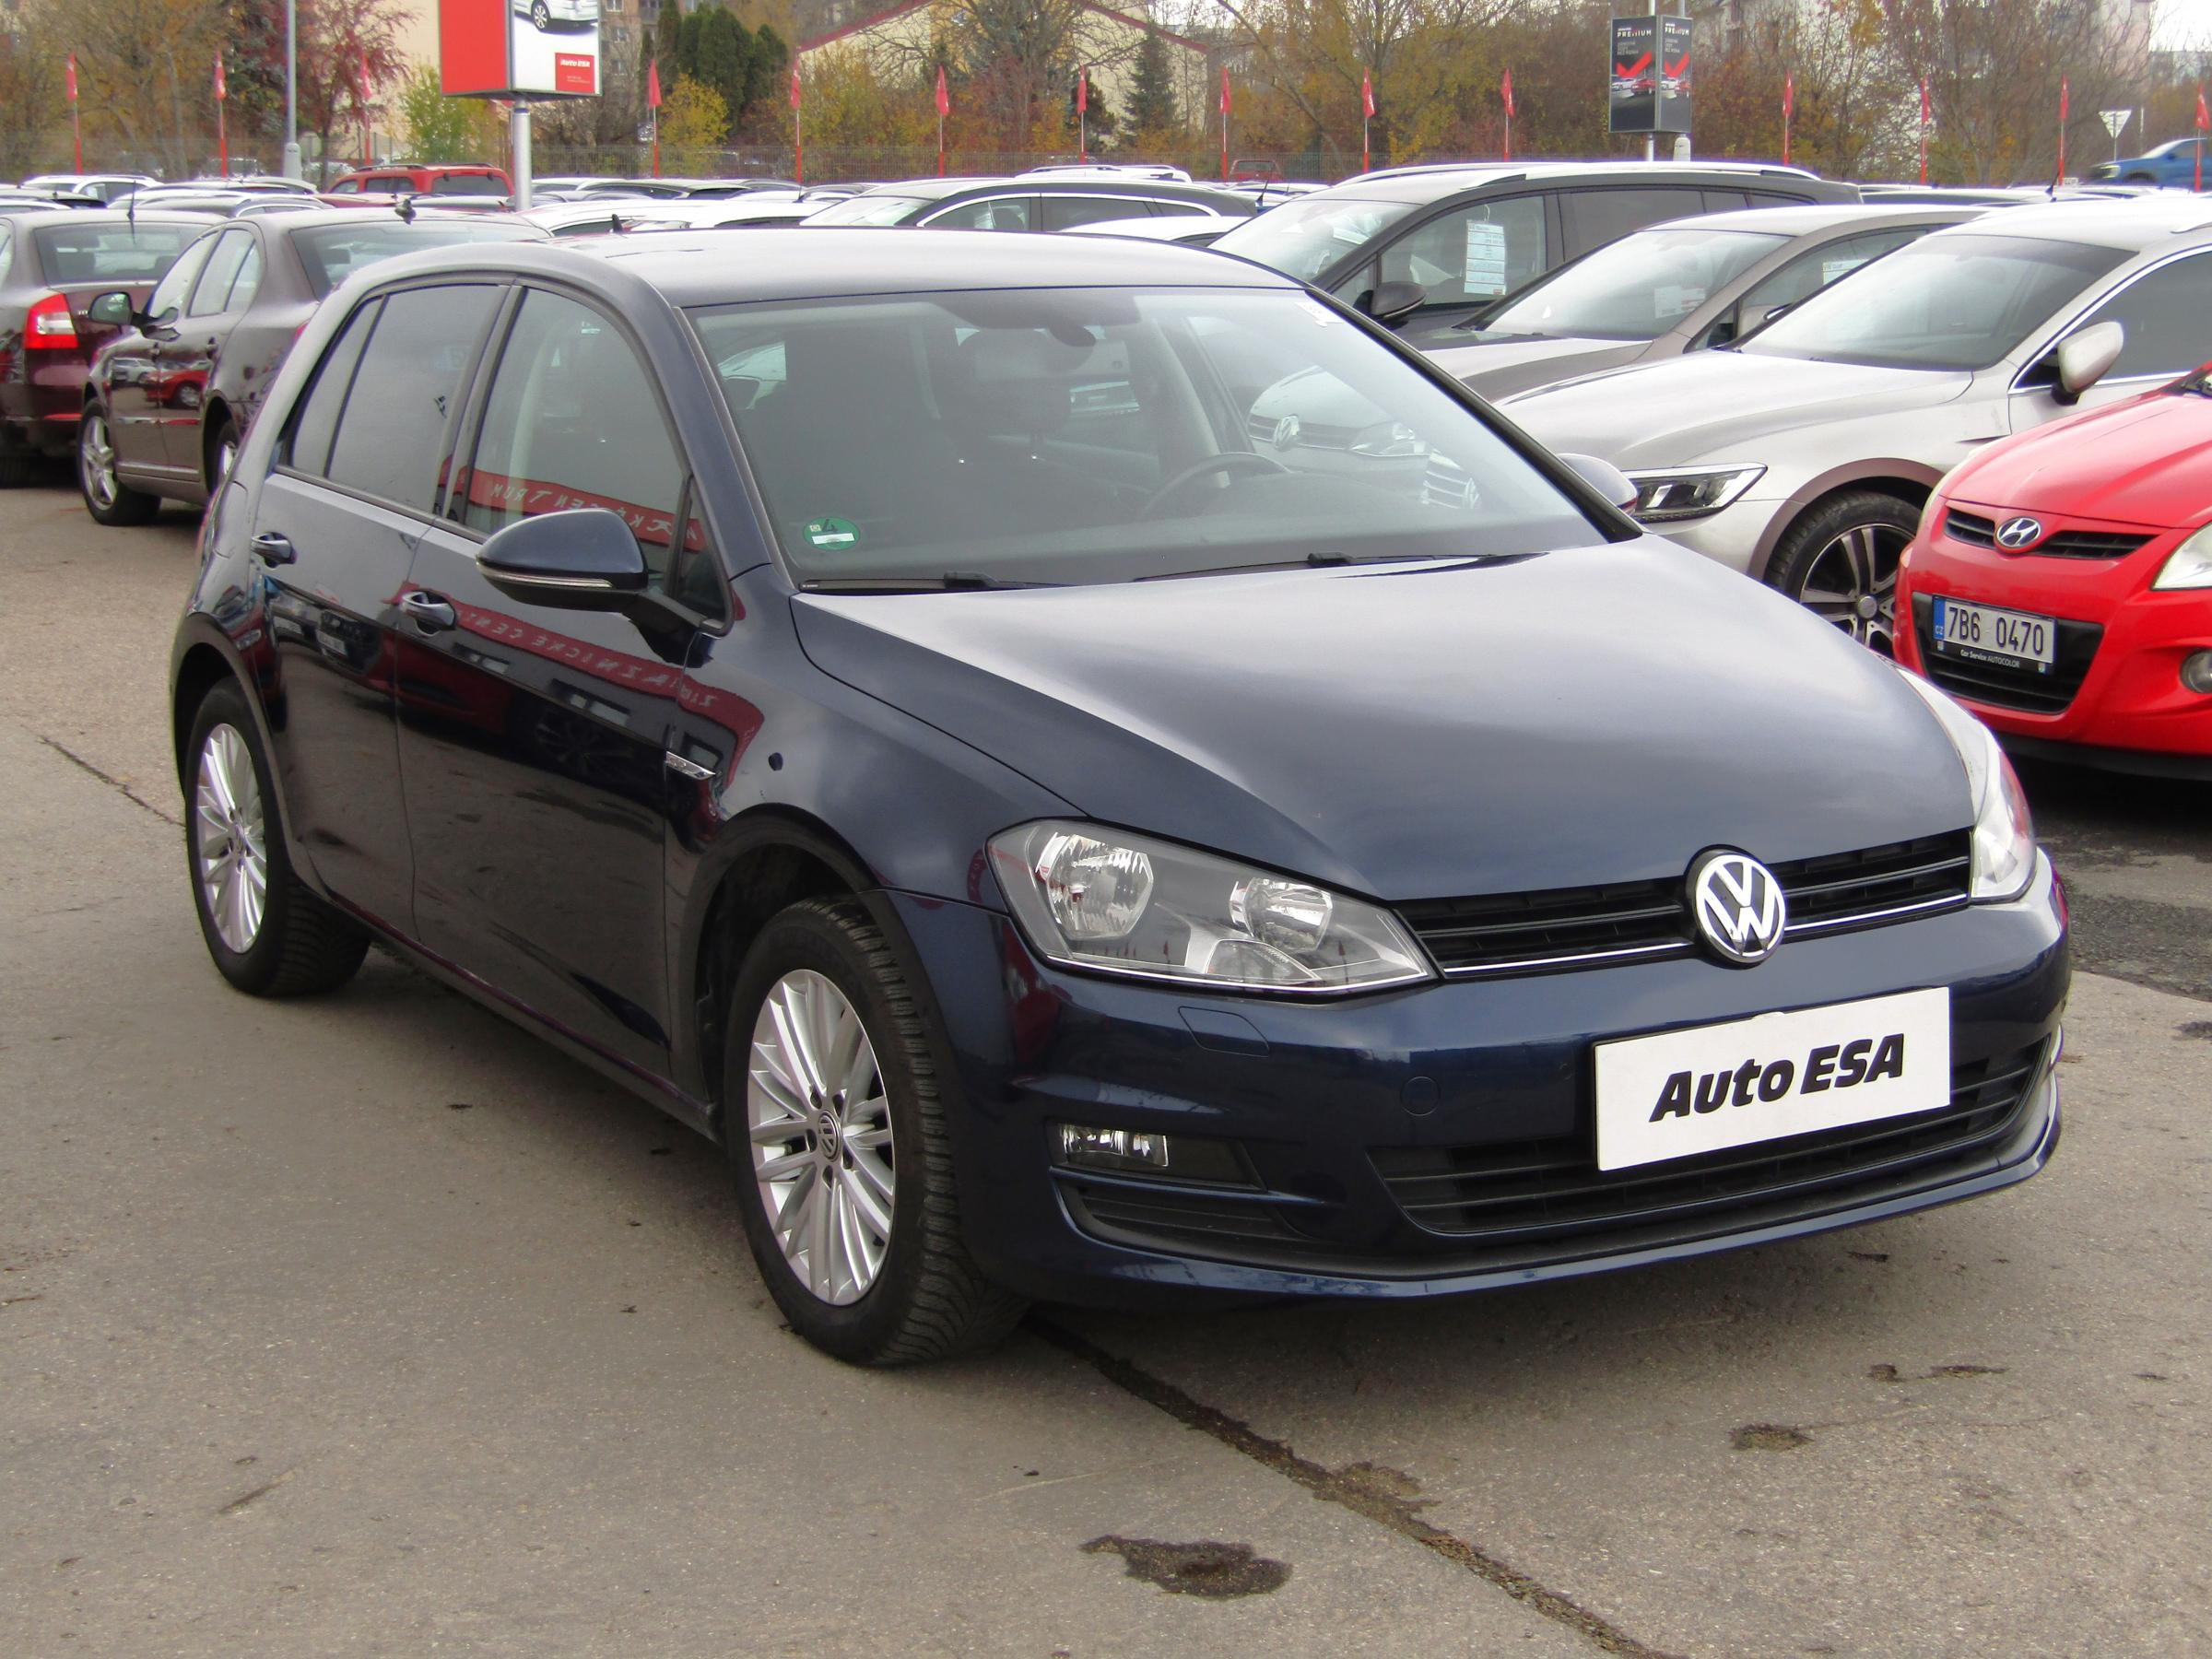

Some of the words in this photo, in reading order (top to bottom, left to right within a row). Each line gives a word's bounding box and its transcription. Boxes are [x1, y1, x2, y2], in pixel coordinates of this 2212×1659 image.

[1948, 606, 1981, 642] 7B6
[1995, 617, 2044, 656] 0470
[1649, 1058, 1795, 1123] Auto
[1799, 1032, 1905, 1095] ESA
